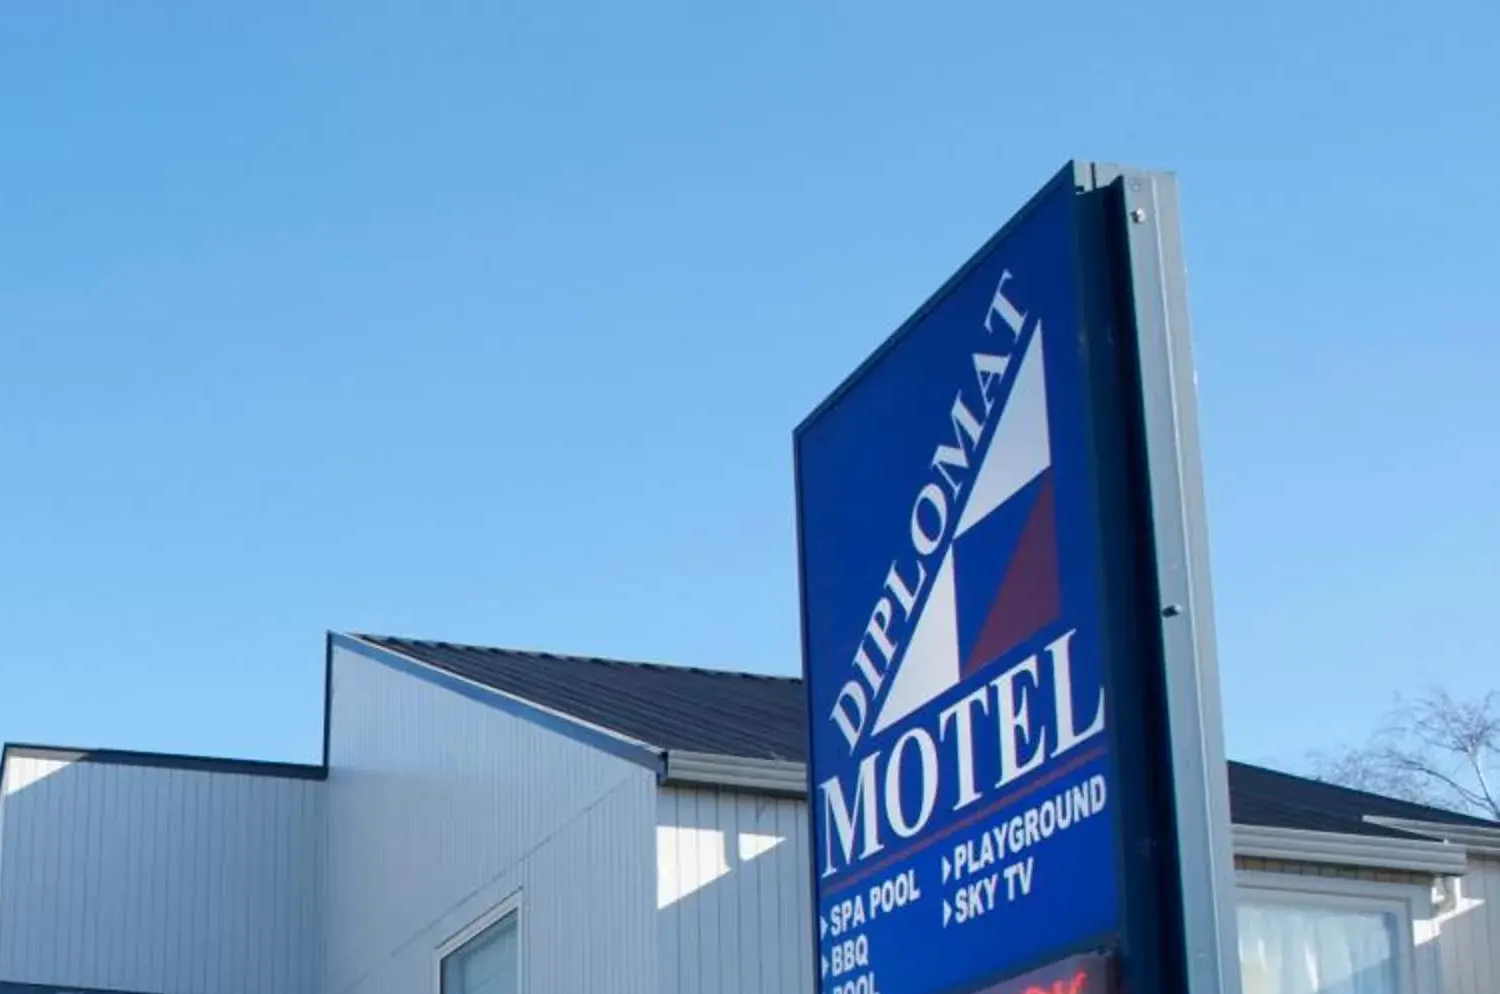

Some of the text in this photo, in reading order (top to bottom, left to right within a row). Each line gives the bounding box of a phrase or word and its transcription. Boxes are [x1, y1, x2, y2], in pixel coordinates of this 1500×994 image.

[829, 268, 1029, 754] DIPLOMAT
[819, 628, 1106, 879] MOTEL
[953, 774, 1107, 881] PLAYGROUND
[830, 869, 921, 936] SPA POOL
[954, 856, 1034, 924] SKY TV
[831, 933, 869, 977] BBQ
